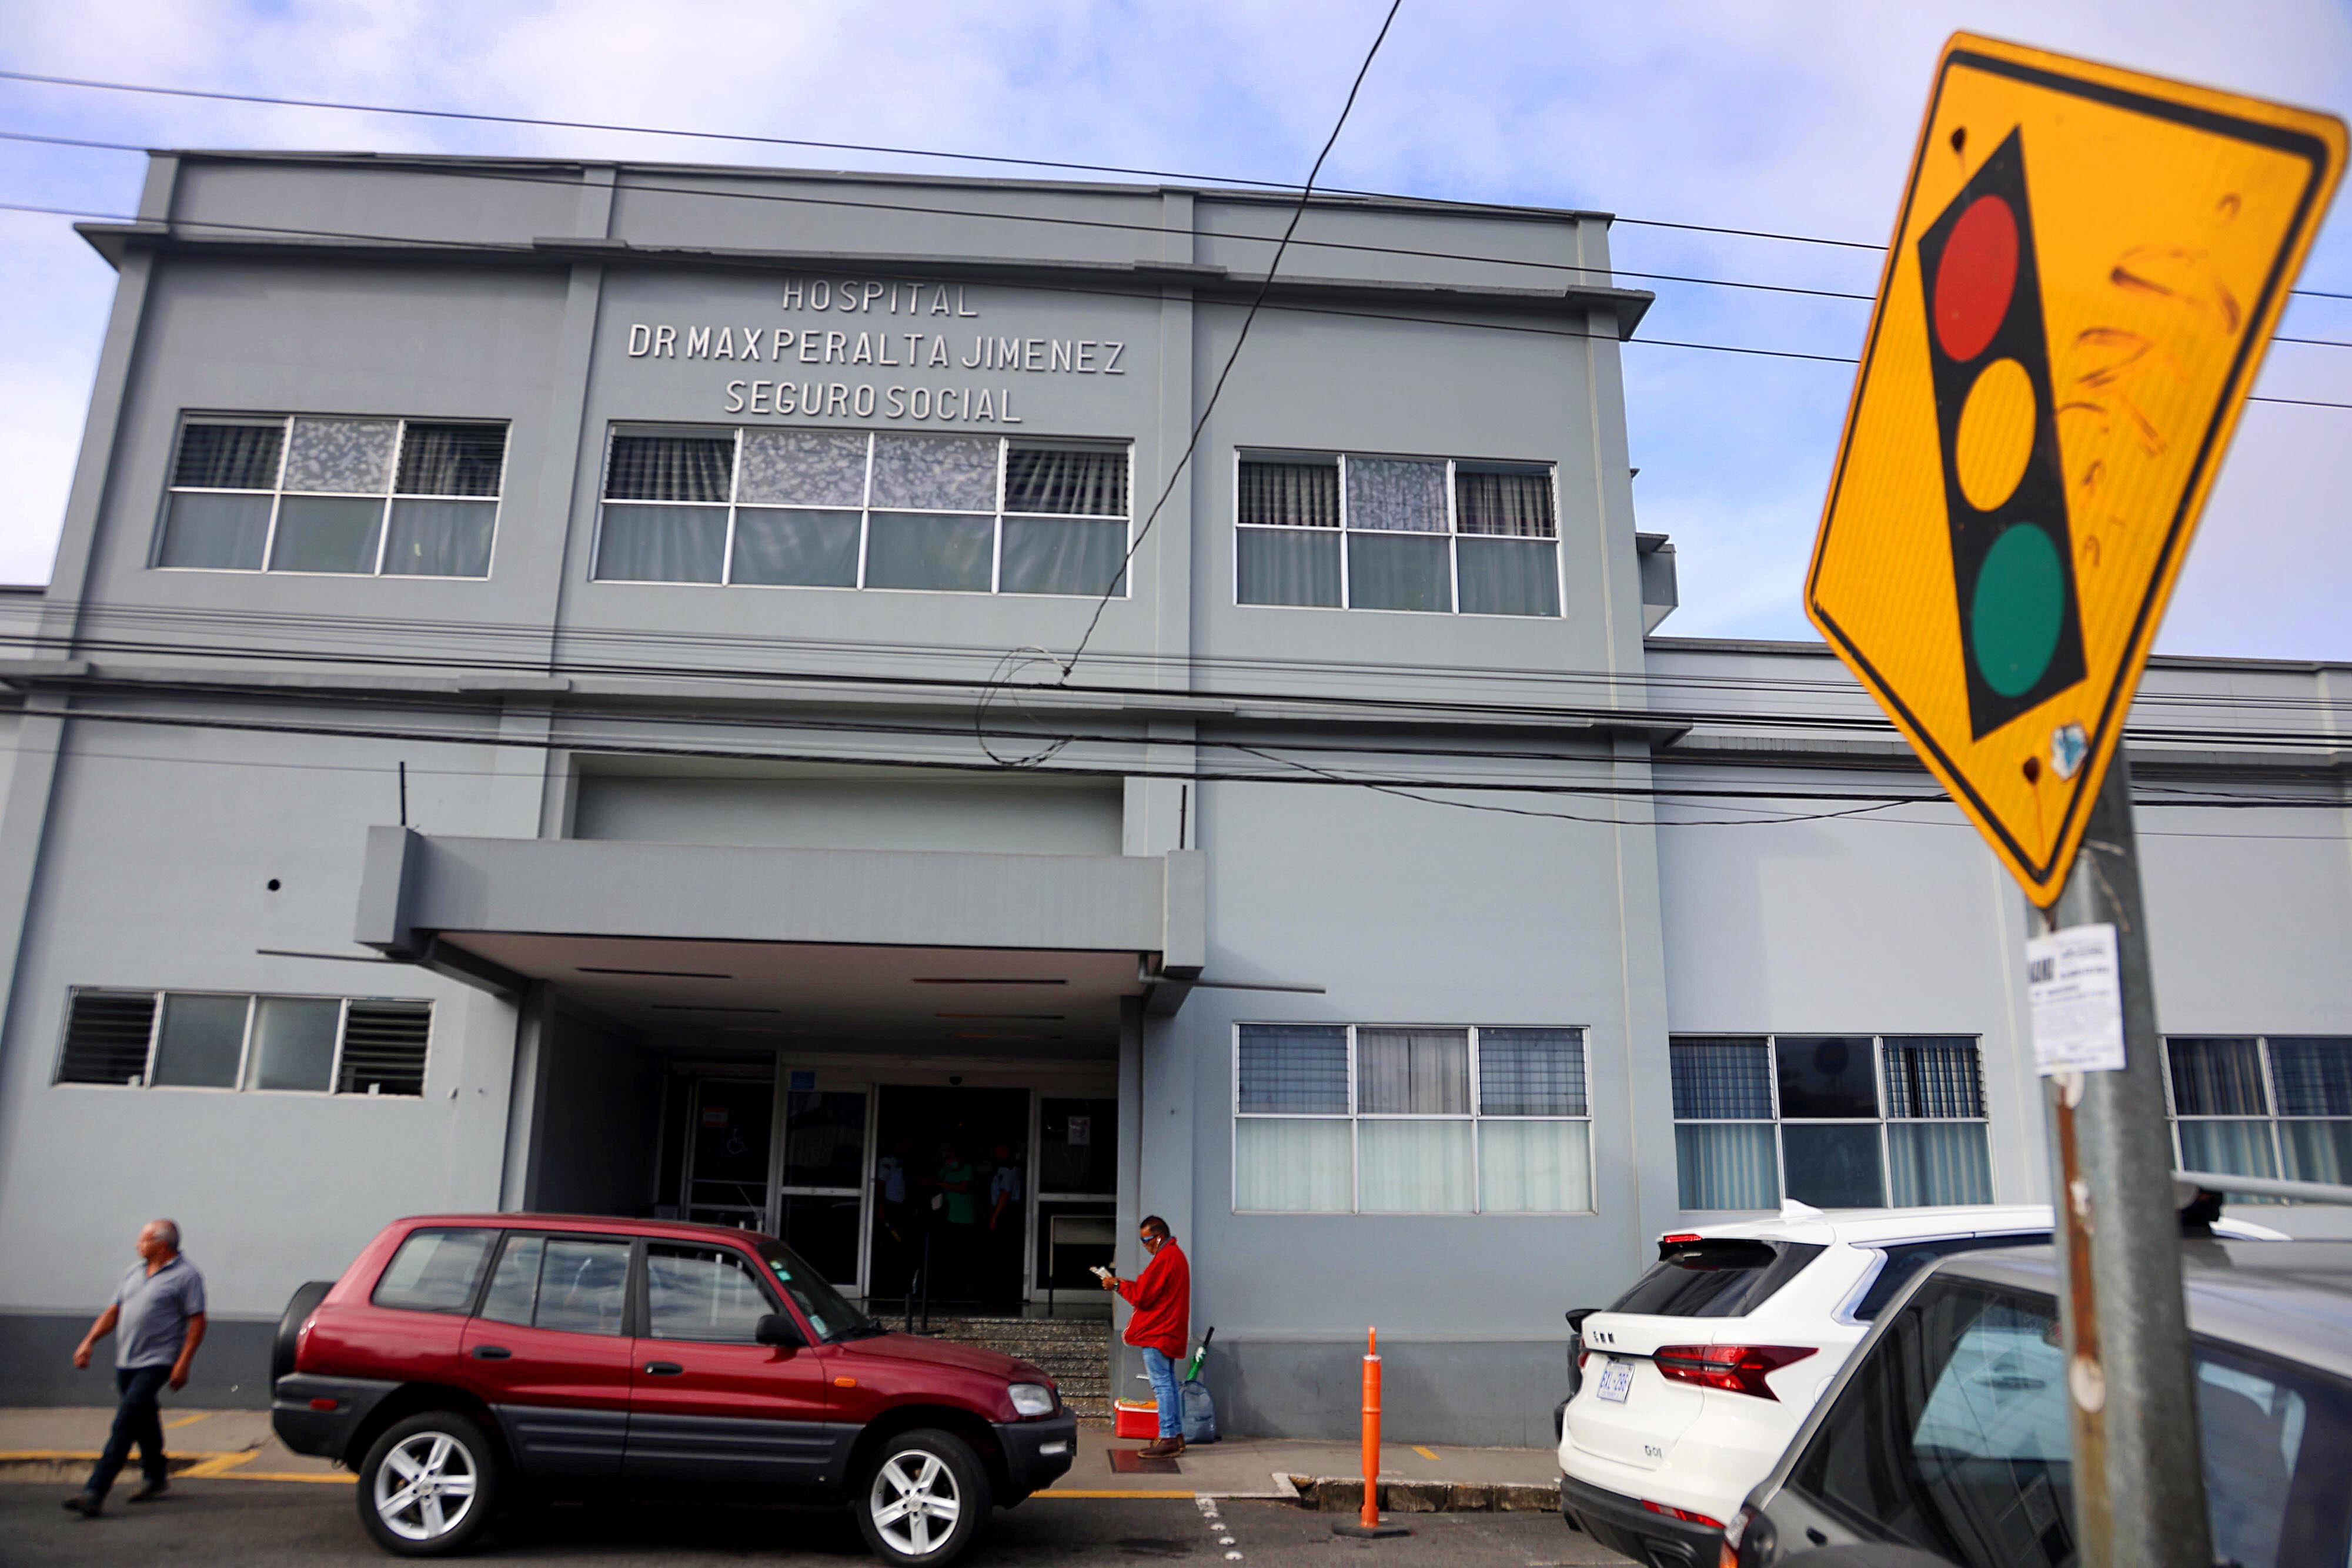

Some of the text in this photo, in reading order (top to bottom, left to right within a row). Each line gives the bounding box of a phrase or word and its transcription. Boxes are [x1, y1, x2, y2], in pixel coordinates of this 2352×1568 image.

[783, 279, 978, 317] HOSPITAL
[628, 324, 1125, 374] DR MAX PERALTA JIMENEZ
[724, 380, 1022, 423] SEGURO SOCIAL
